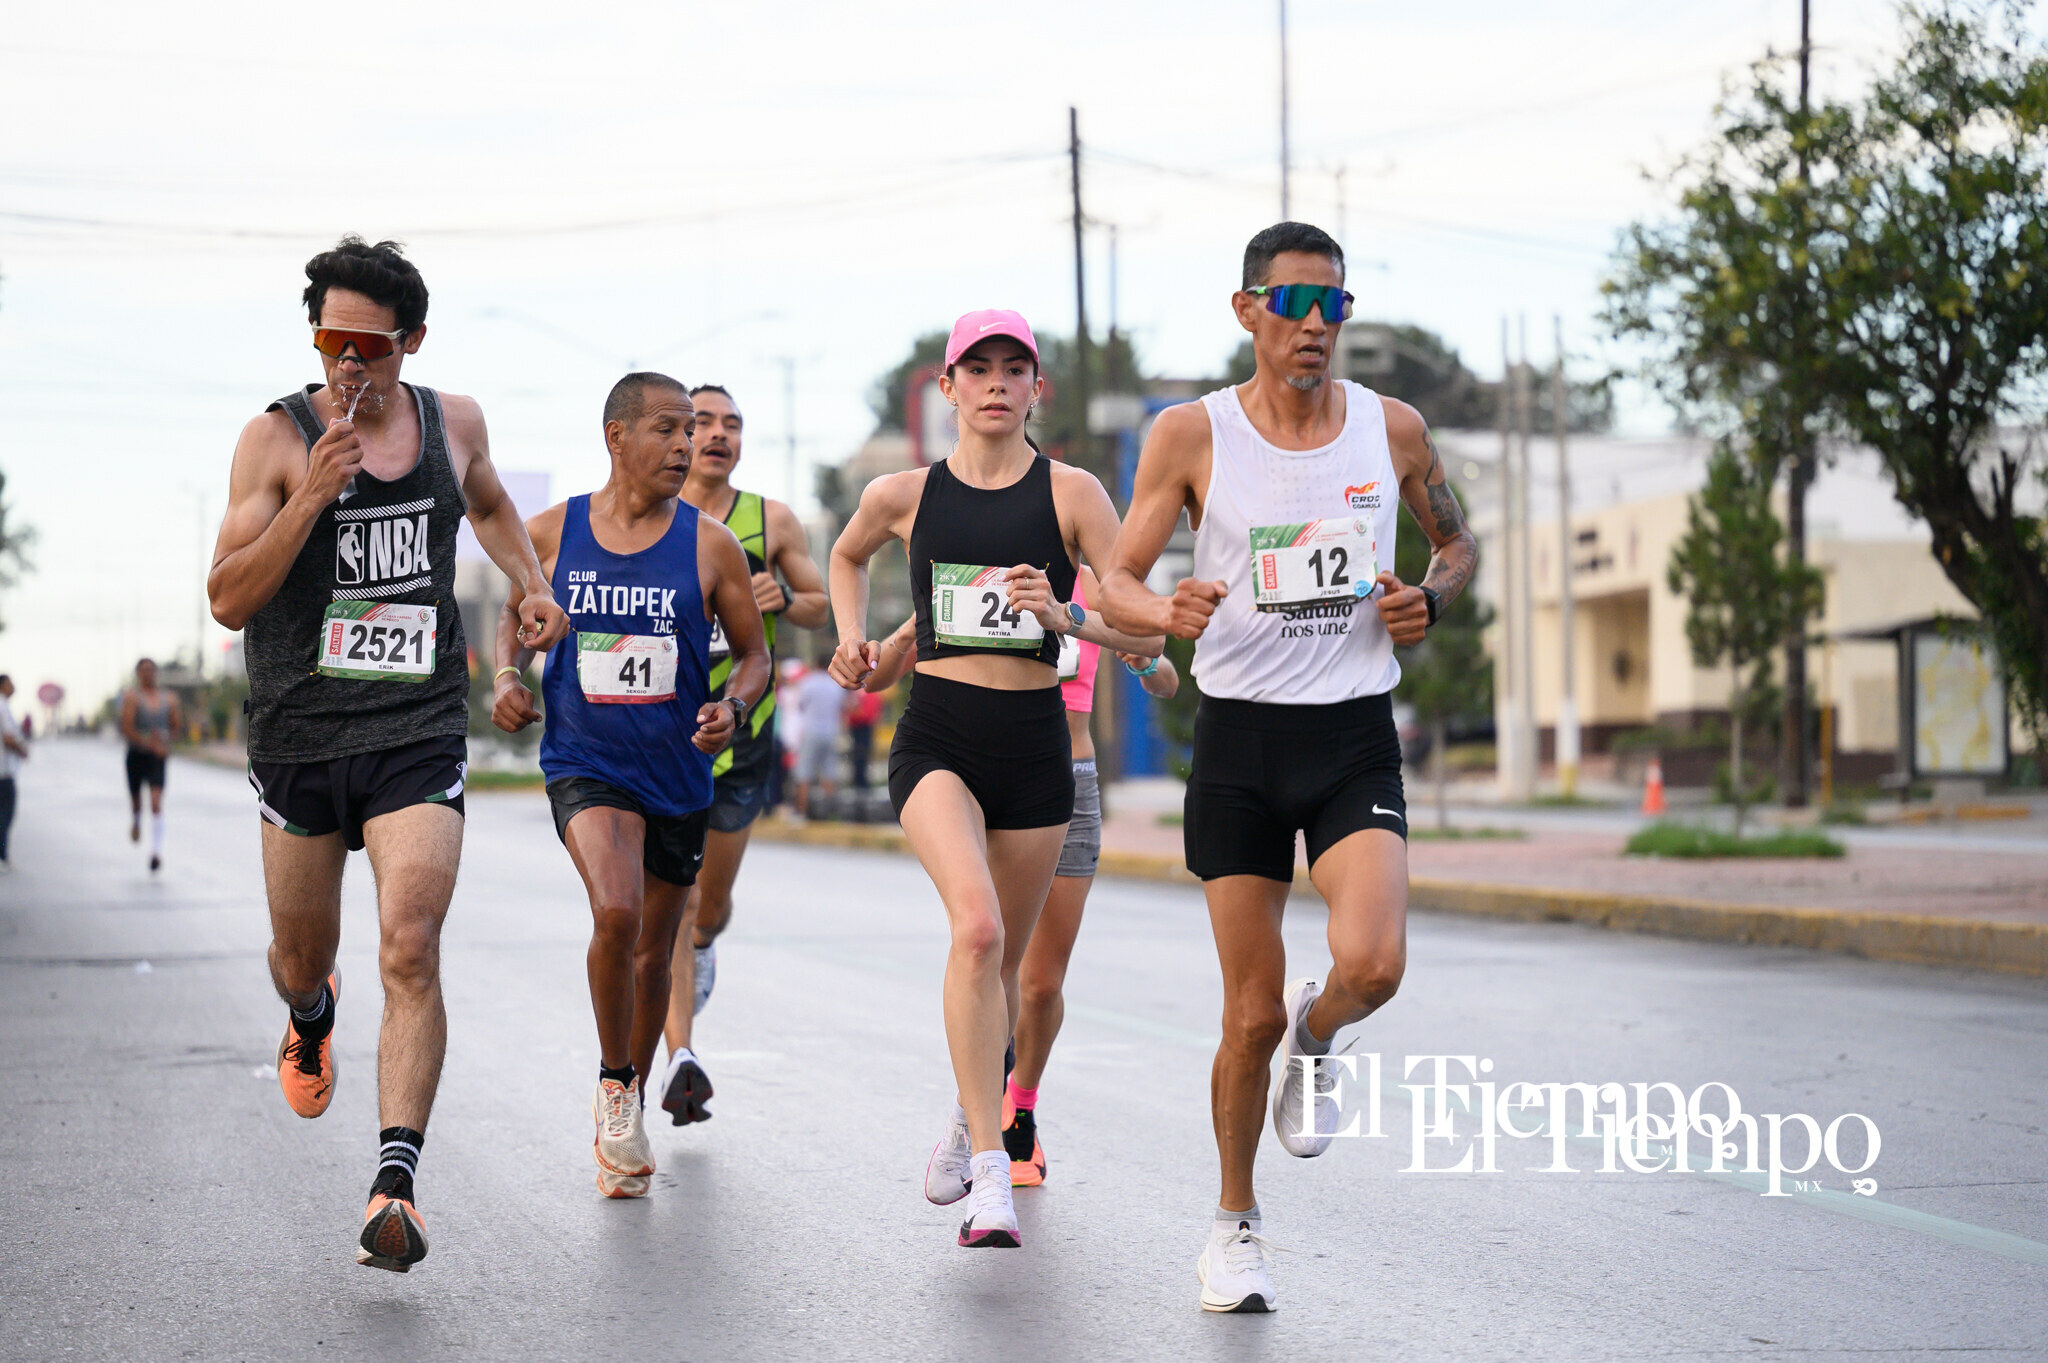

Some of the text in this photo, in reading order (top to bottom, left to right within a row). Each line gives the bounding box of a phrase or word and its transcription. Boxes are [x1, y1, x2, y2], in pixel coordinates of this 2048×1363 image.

[369, 514, 432, 581] NBA
[568, 570, 597, 582] CLUB
[1263, 555, 1276, 589] SALTILLO
[1308, 547, 1349, 588] 12
[568, 584, 677, 618] ZATOPEK
[943, 590, 952, 621] COAHUILA
[980, 591, 1021, 629] 24
[331, 624, 343, 654] SALTILLO
[653, 618, 674, 634] ZAC
[1281, 621, 1352, 639] nos une.
[347, 624, 424, 665] 2521
[619, 656, 652, 688] 41
